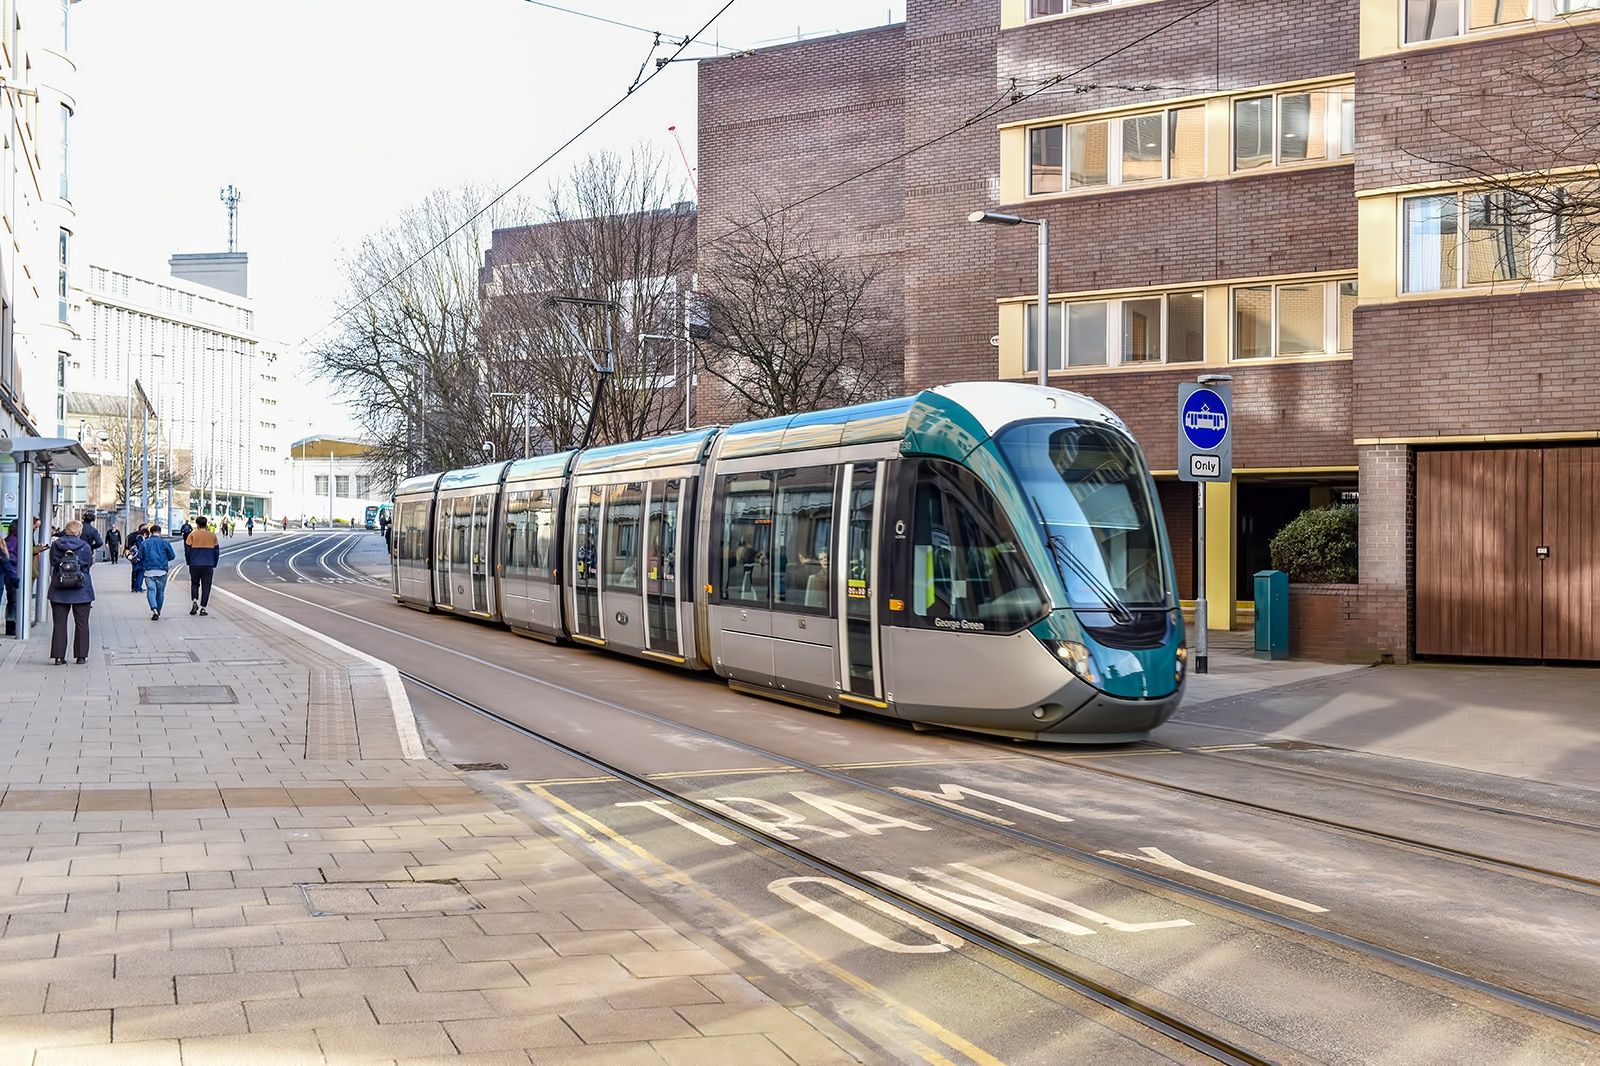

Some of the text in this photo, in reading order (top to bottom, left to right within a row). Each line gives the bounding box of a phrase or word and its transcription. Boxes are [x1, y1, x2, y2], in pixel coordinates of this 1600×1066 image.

[1195, 460, 1216, 472] Only
[935, 617, 984, 631] George Green
[615, 784, 1074, 845] TRAM
[767, 846, 1330, 954] ONLY
